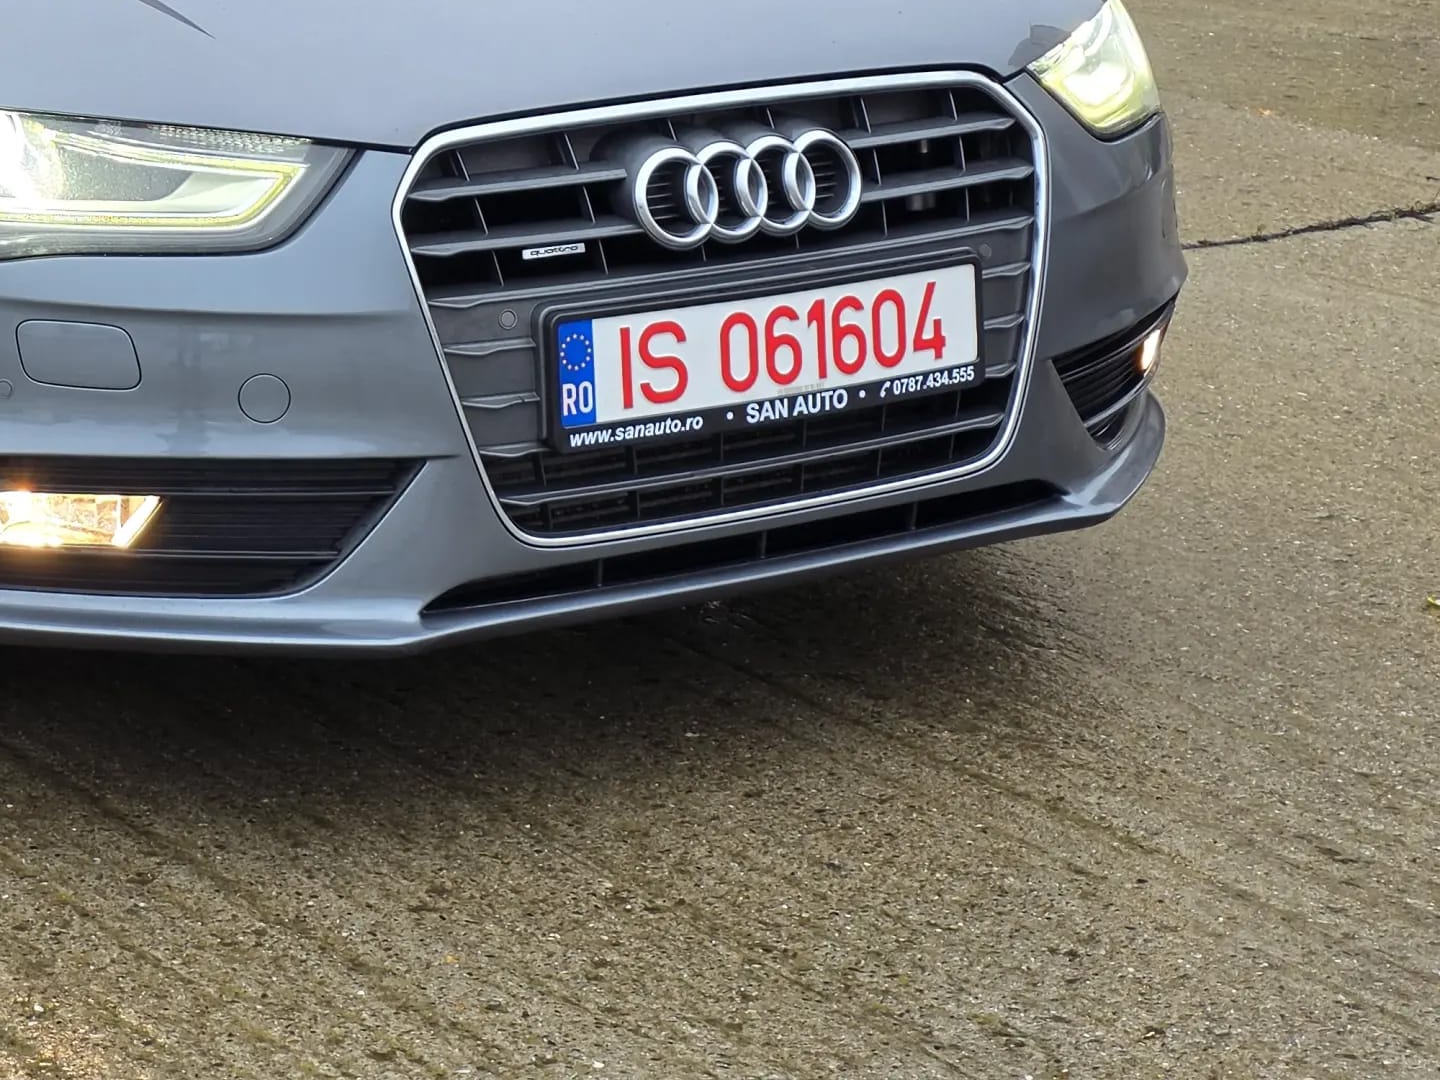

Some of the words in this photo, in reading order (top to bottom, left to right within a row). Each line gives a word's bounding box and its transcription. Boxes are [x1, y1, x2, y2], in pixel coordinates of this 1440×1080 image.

[620, 320, 689, 410] IS
[719, 281, 947, 393] 061604
[562, 380, 594, 417] RO
[569, 416, 704, 448] www.sanauto.ro
[746, 398, 790, 424] SAN
[792, 388, 848, 412] AUTO
[892, 366, 975, 396] 0787.434.555
